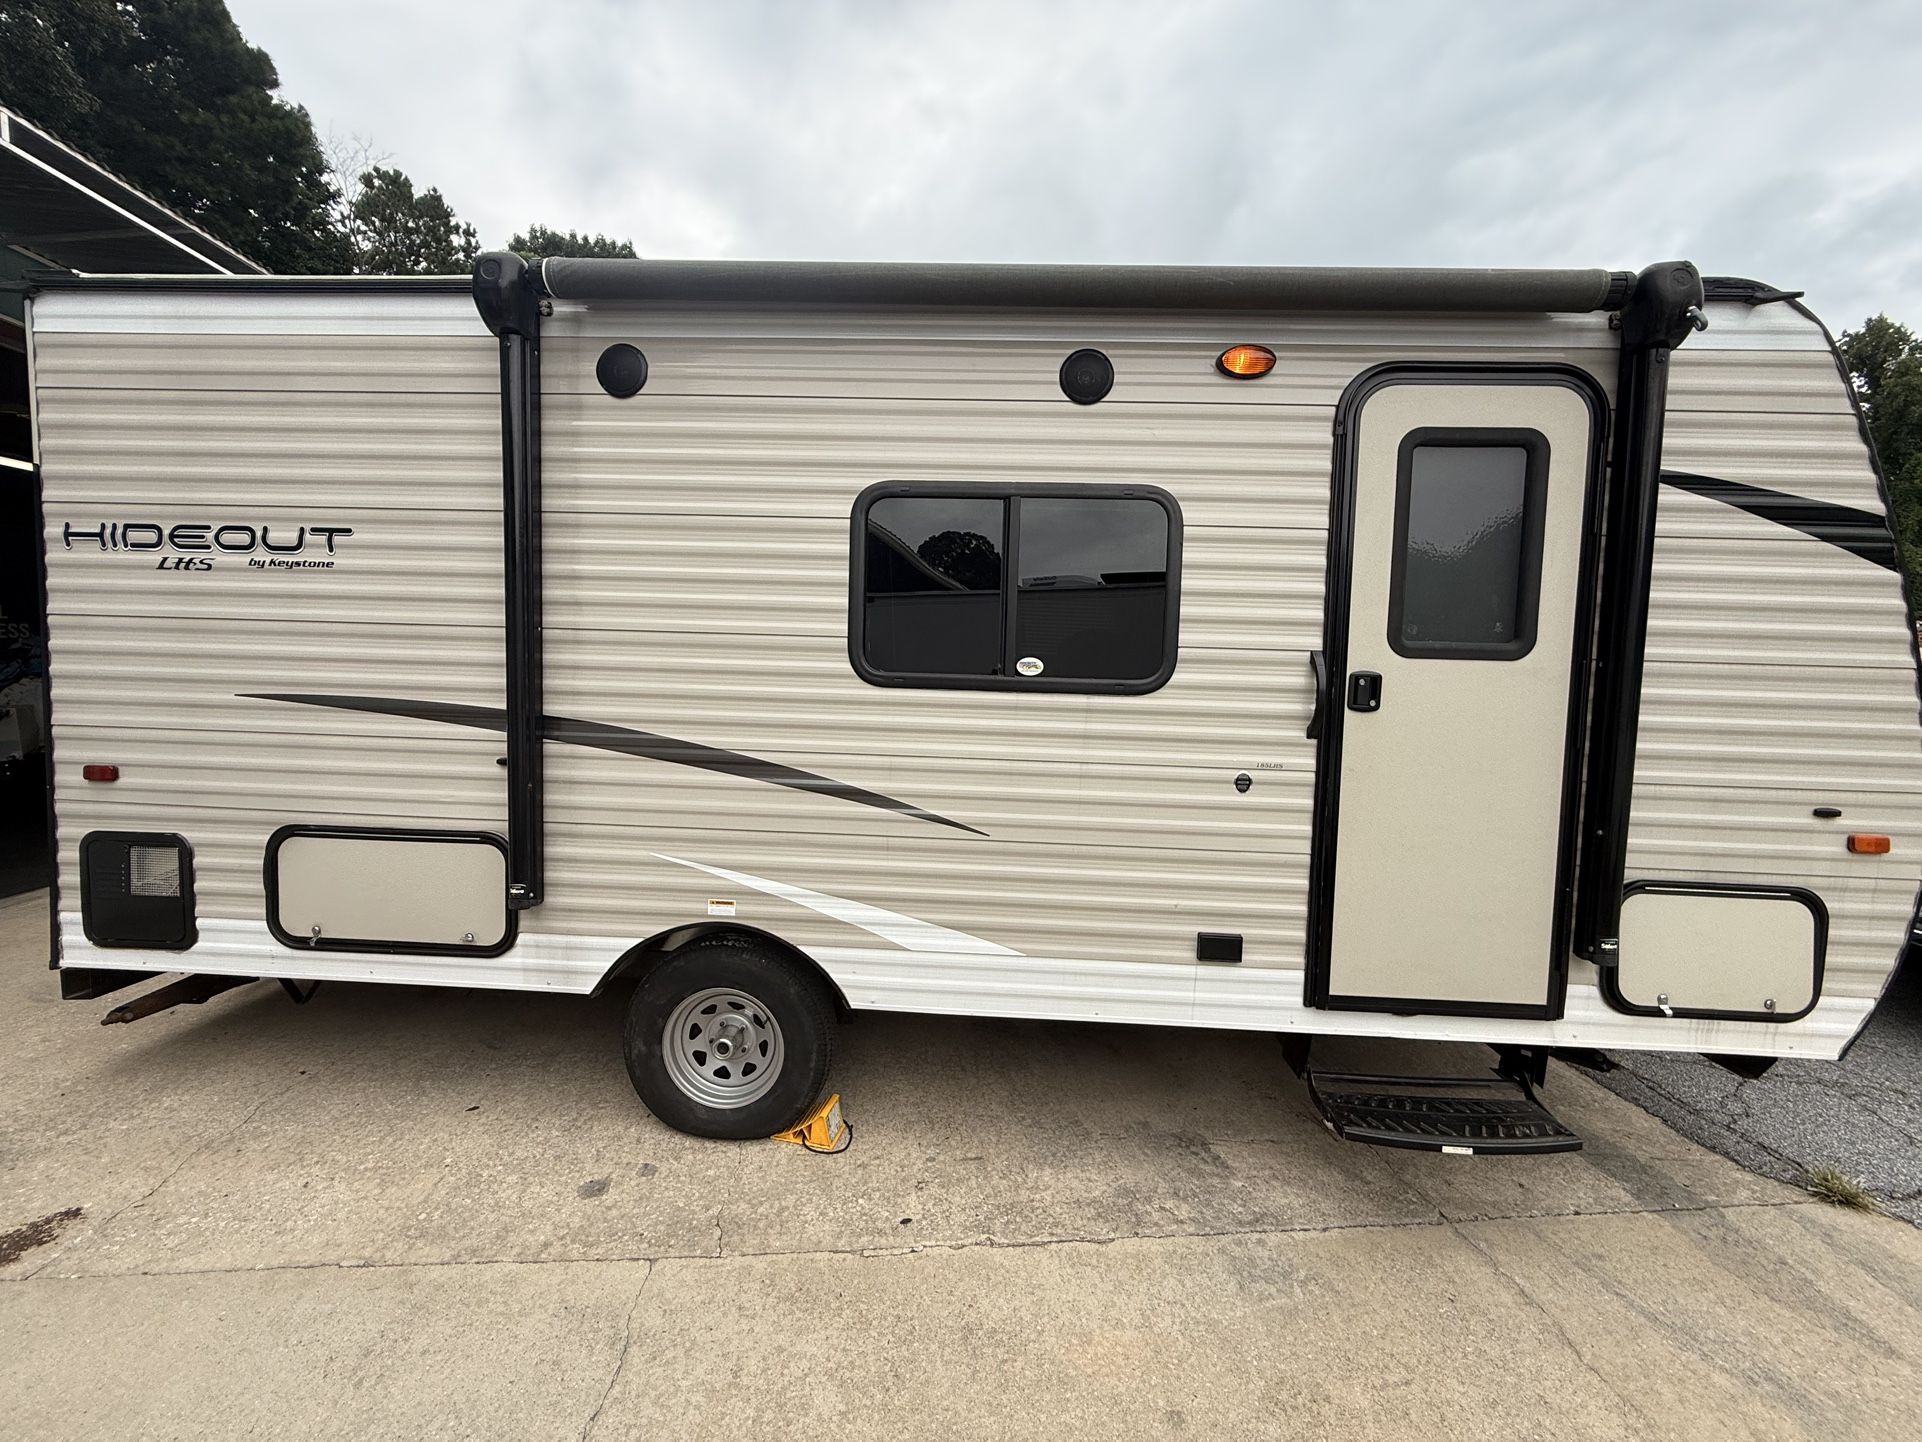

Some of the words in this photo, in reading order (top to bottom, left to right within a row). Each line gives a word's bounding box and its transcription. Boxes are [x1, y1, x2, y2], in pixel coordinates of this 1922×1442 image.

[63, 521, 354, 556] HIDEOUT
[156, 556, 216, 571] LHS
[248, 557, 268, 570] by
[269, 558, 335, 571] Keystone
